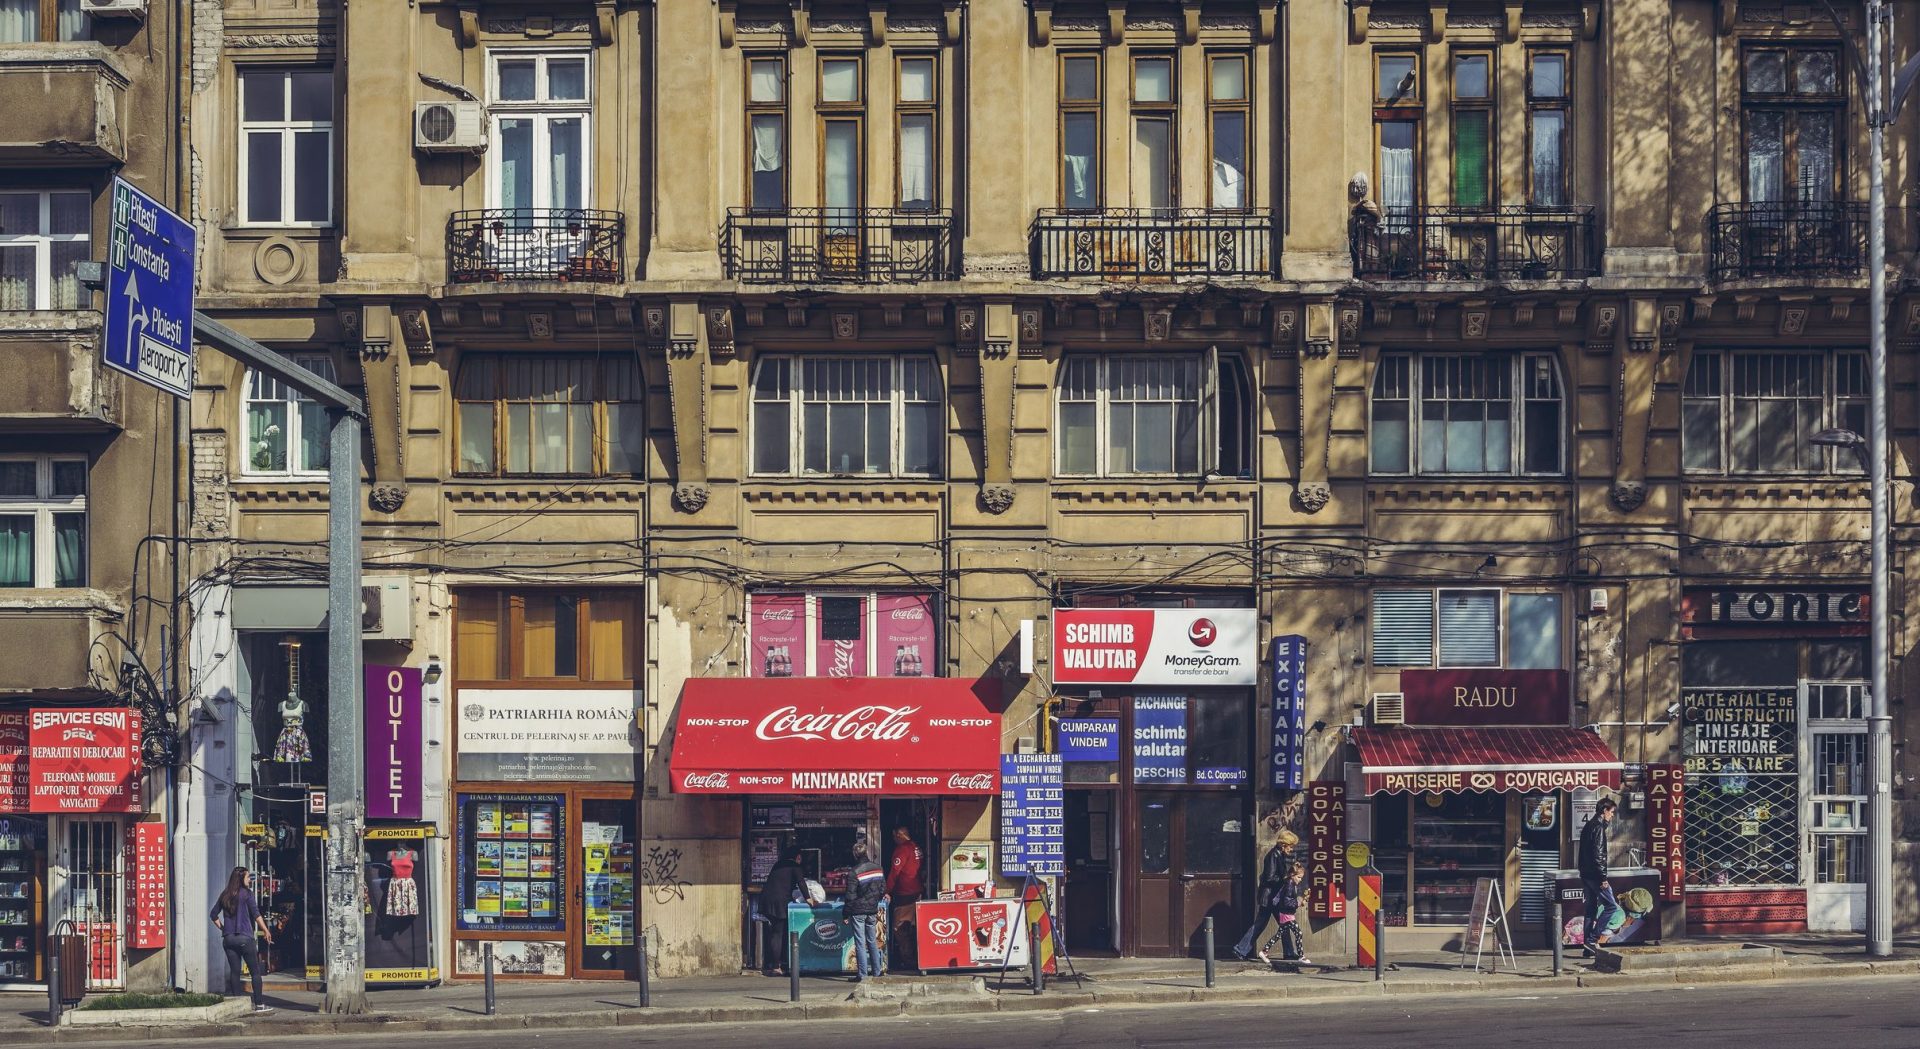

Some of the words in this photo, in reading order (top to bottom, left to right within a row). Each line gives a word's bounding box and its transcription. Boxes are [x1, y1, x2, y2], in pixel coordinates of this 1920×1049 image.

[141, 338, 176, 377] Aeroport
[892, 608, 924, 620] Coca-Cola
[1066, 624, 1134, 644] SCHIMB
[1064, 650, 1136, 668] VALUTAR
[1165, 655, 1239, 668] MoneyGram
[1134, 697, 1186, 709] EXCHANGE
[1454, 687, 1516, 707] RADU
[1685, 693, 1776, 706] MATERIALE
[1780, 696, 1792, 706] DE
[489, 710, 573, 720] PATRIARHIA
[1274, 642, 1290, 784] EXCHANGE
[1294, 642, 1304, 784] EXCHANGE
[33, 712, 92, 730] SERVICE
[93, 712, 126, 730] GSM
[687, 718, 749, 726] NON-STOP
[756, 705, 921, 740] Coca-Cola
[930, 718, 992, 726] NON-STOP
[1061, 723, 1116, 732] CUMPARAM
[526, 732, 576, 742] PELERINAJ
[608, 733, 637, 741] PAVEL
[1134, 726, 1186, 740] schimb
[1696, 724, 1770, 738] FINISAJE
[387, 670, 402, 814] OUTLET
[1070, 738, 1107, 747] VINDEM
[1696, 740, 1778, 754] INTERIOARE
[32, 746, 72, 758] REPARATII
[73, 746, 80, 758] SI
[82, 746, 126, 758] DEBLOCARI
[1134, 742, 1187, 756] valutar
[1020, 754, 1050, 762] EXCHANGE
[1052, 754, 1062, 762] SRL
[1017, 766, 1042, 774] CUMPARAM
[1044, 766, 1062, 774] VINDEM
[1134, 768, 1186, 778] DESCHIS
[1196, 769, 1207, 779] Bd.
[1208, 770, 1214, 779] C.
[1215, 770, 1238, 782] Coposu
[42, 772, 84, 782] TELEFOANE
[86, 772, 116, 782] MOBILE
[684, 772, 730, 789] Coca-Cola
[740, 776, 784, 784] NON-STOP
[792, 772, 884, 789] MINIMARKET
[894, 776, 938, 784] NON-STOP
[948, 773, 994, 790] Coca-Cola
[1386, 774, 1462, 788] PATISERIE
[1505, 771, 1598, 787] COVRIGARIE
[34, 786, 80, 795] LAPTOP-URI
[88, 786, 124, 795] CONSOLE
[1002, 791, 1015, 799] EURO
[60, 798, 98, 808] NAVIGATII
[1672, 770, 1682, 896] COVRIGARIE
[1002, 846, 1024, 854] ELVETIAN
[1313, 786, 1327, 912] COVRIGARIE
[1332, 787, 1344, 912] PATISERIE
[140, 920, 148, 945] GSM
